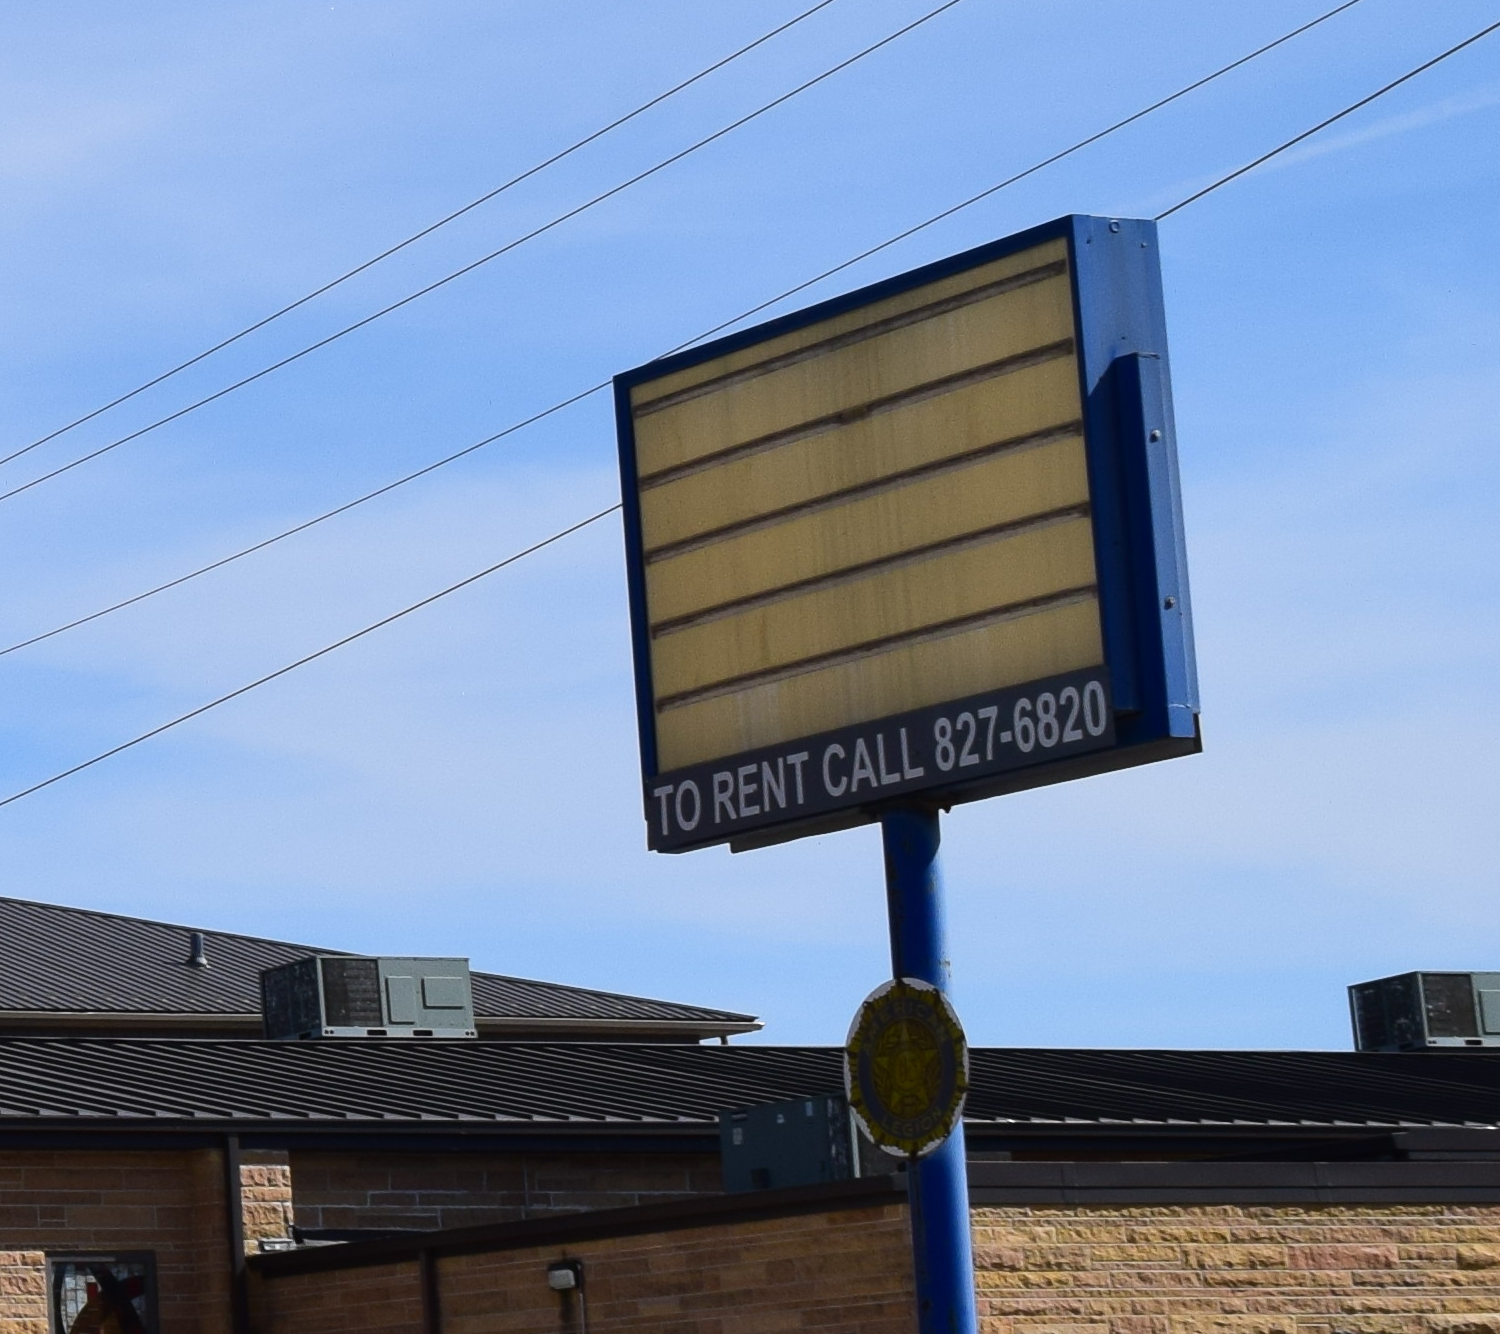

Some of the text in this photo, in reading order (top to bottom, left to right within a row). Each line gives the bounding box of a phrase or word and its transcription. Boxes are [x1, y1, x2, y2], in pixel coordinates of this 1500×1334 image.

[653, 679, 1108, 836] TO RENT CALL 827-6820
